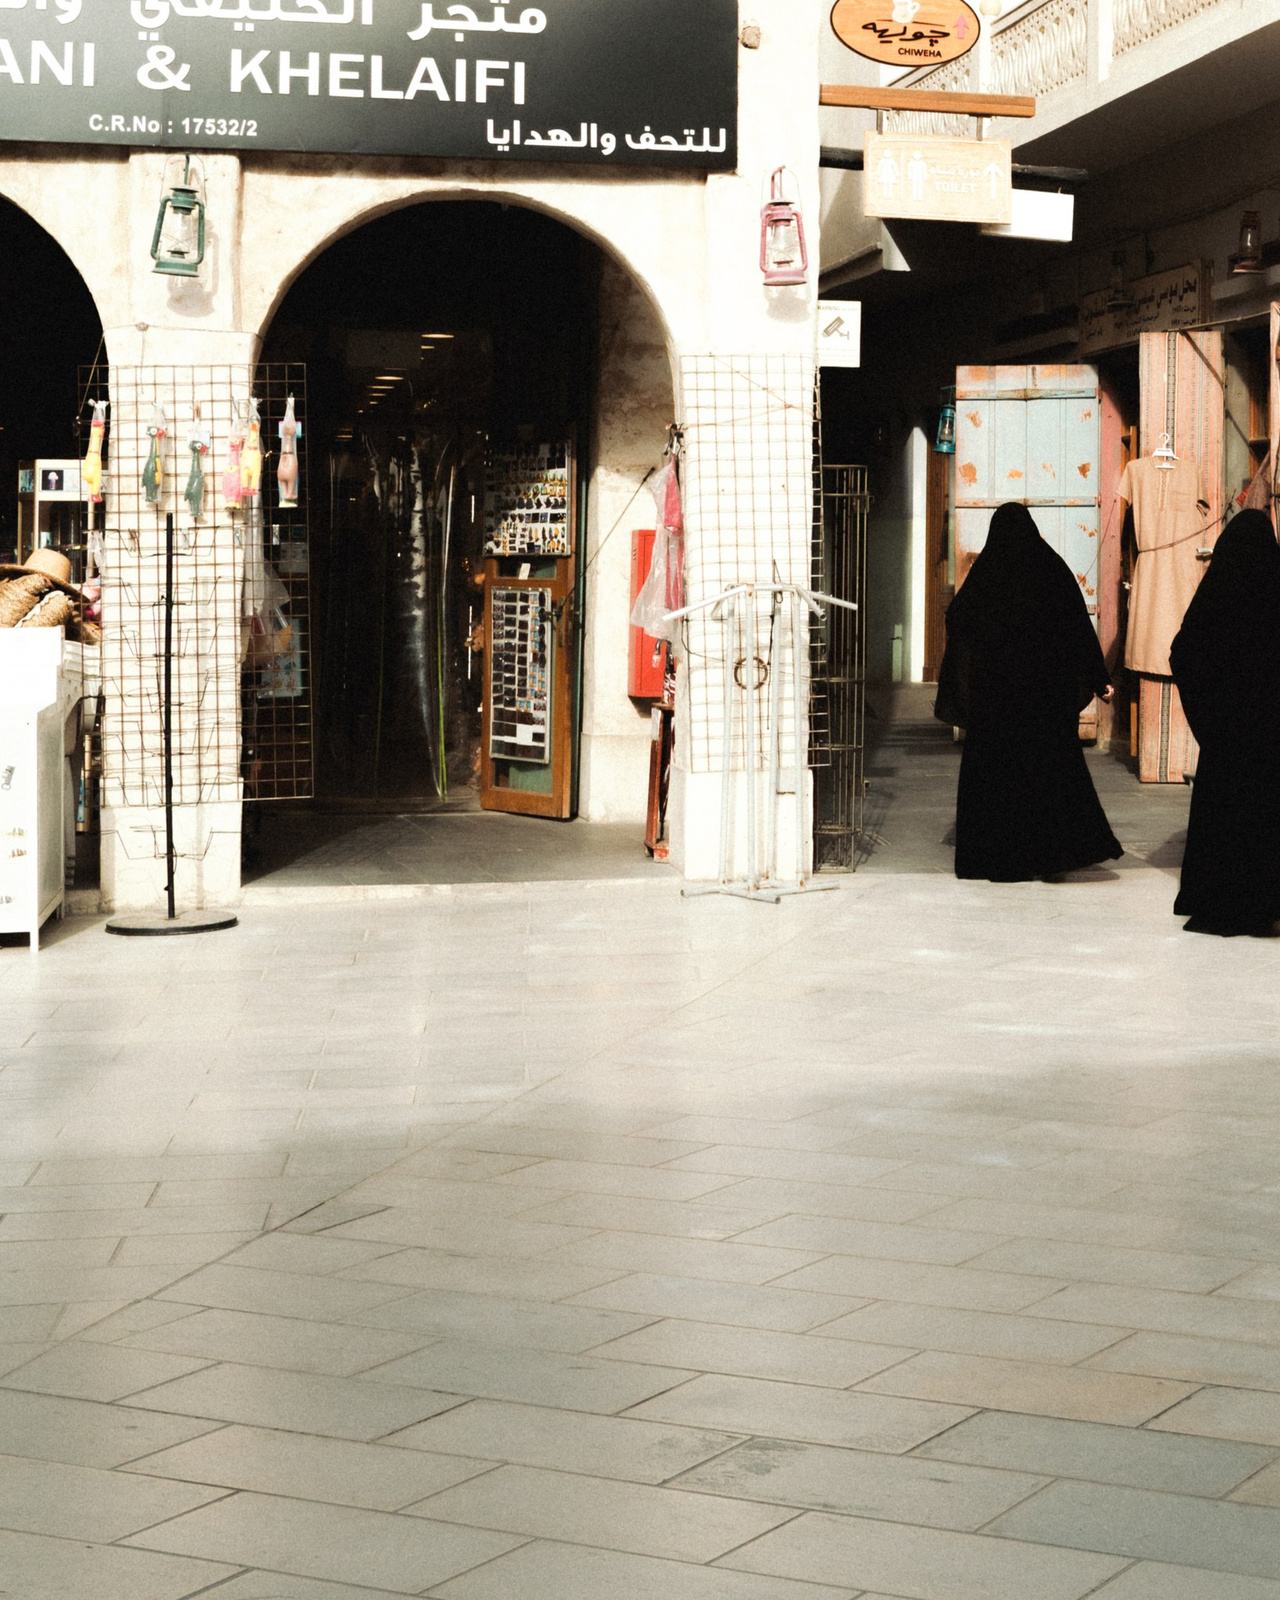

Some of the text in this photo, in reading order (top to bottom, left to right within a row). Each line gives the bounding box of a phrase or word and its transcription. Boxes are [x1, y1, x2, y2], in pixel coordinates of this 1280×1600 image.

[897, 47, 943, 58] CHIWEHA
[136, 44, 192, 92] &
[230, 49, 526, 104] KHELAIFI
[181, 117, 258, 137] 17532/2
[487, 118, 727, 156] للتحف والهدايا
[935, 180, 977, 193] TOILET
